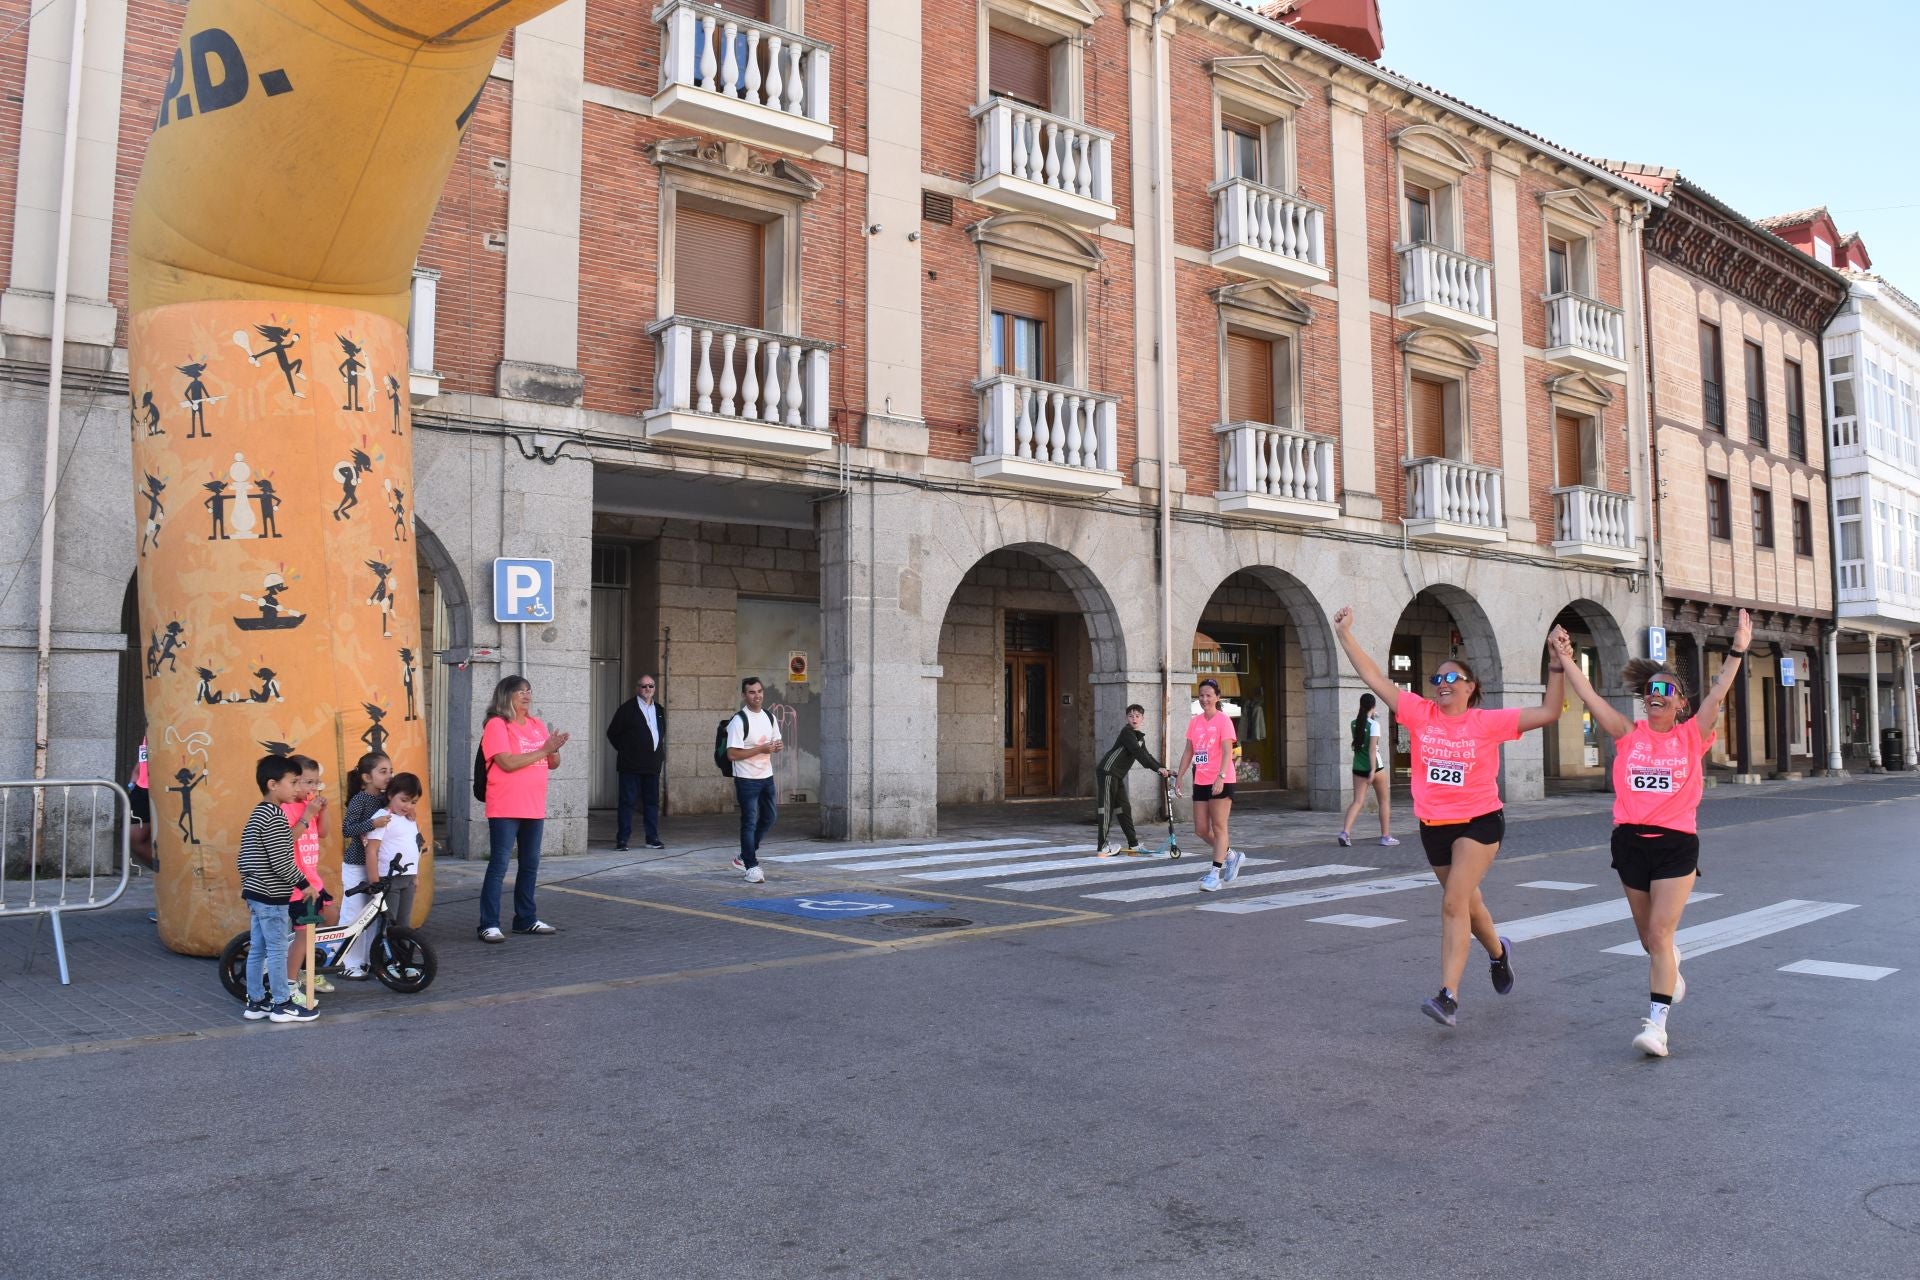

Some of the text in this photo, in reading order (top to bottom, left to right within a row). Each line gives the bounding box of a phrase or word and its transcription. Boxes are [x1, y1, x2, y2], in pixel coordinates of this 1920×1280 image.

[507, 566, 541, 614] P
[1653, 631, 1662, 657] P
[1437, 738, 1476, 749] marcha
[1422, 745, 1476, 759] contra el
[1631, 749, 1646, 761] En
[1430, 768, 1462, 783] 628
[1673, 767, 1687, 779] el
[1634, 776, 1669, 790] 625
